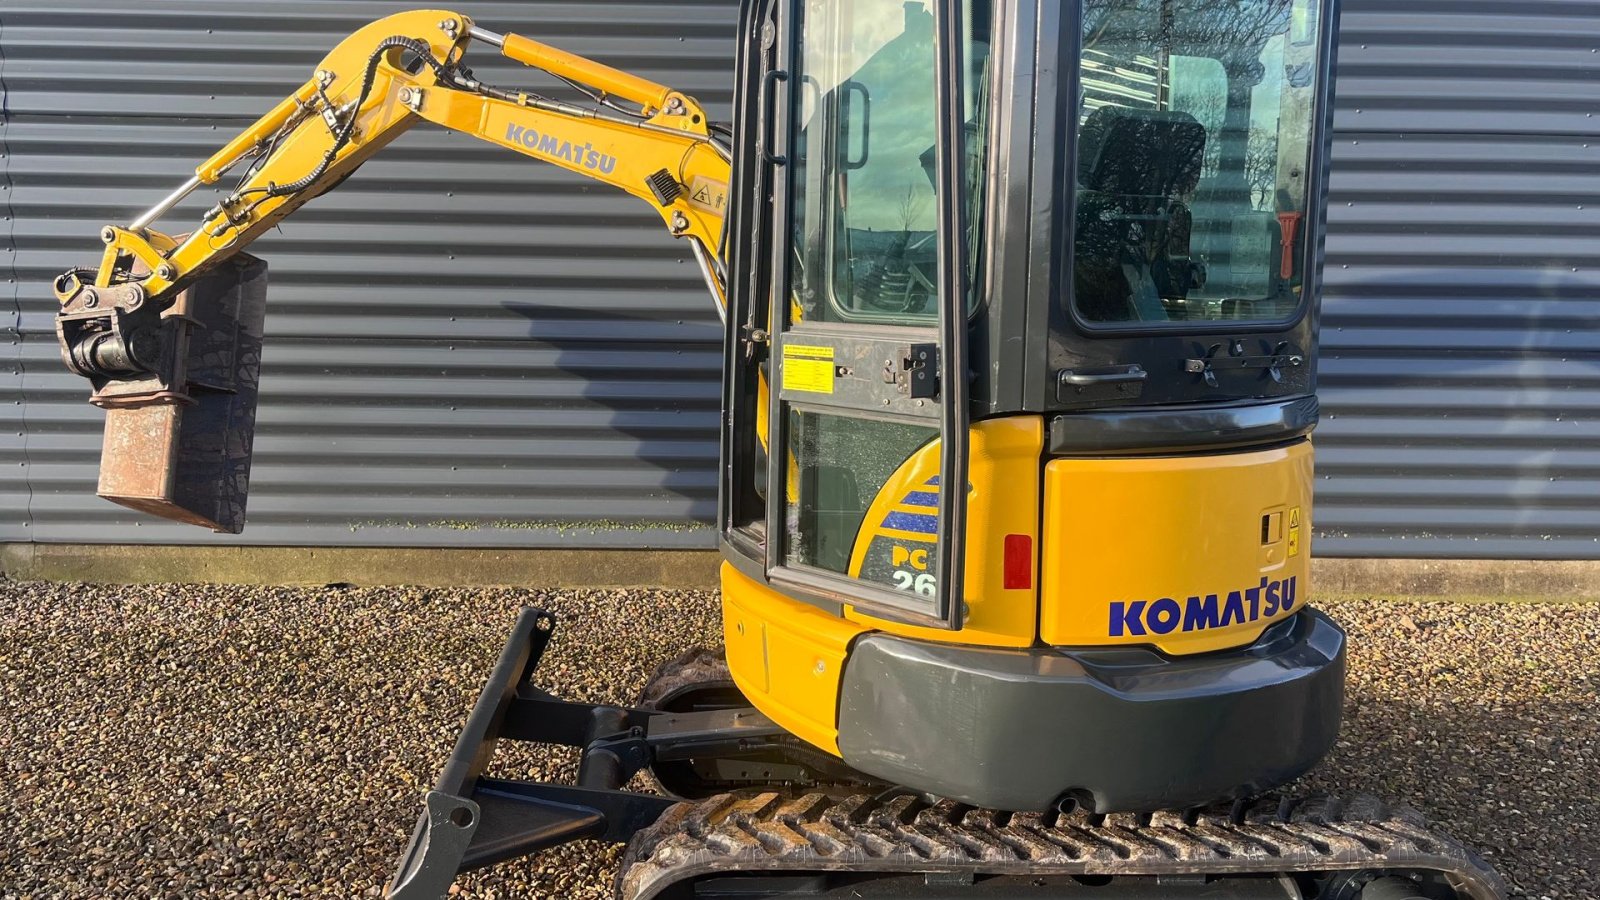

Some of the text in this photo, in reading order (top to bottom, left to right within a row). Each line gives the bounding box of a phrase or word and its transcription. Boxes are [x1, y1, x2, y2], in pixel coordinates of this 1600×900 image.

[505, 122, 617, 175] KOMATSU
[891, 545, 927, 570] PC
[892, 570, 937, 598] 26
[1108, 575, 1297, 637] KOMATSU
